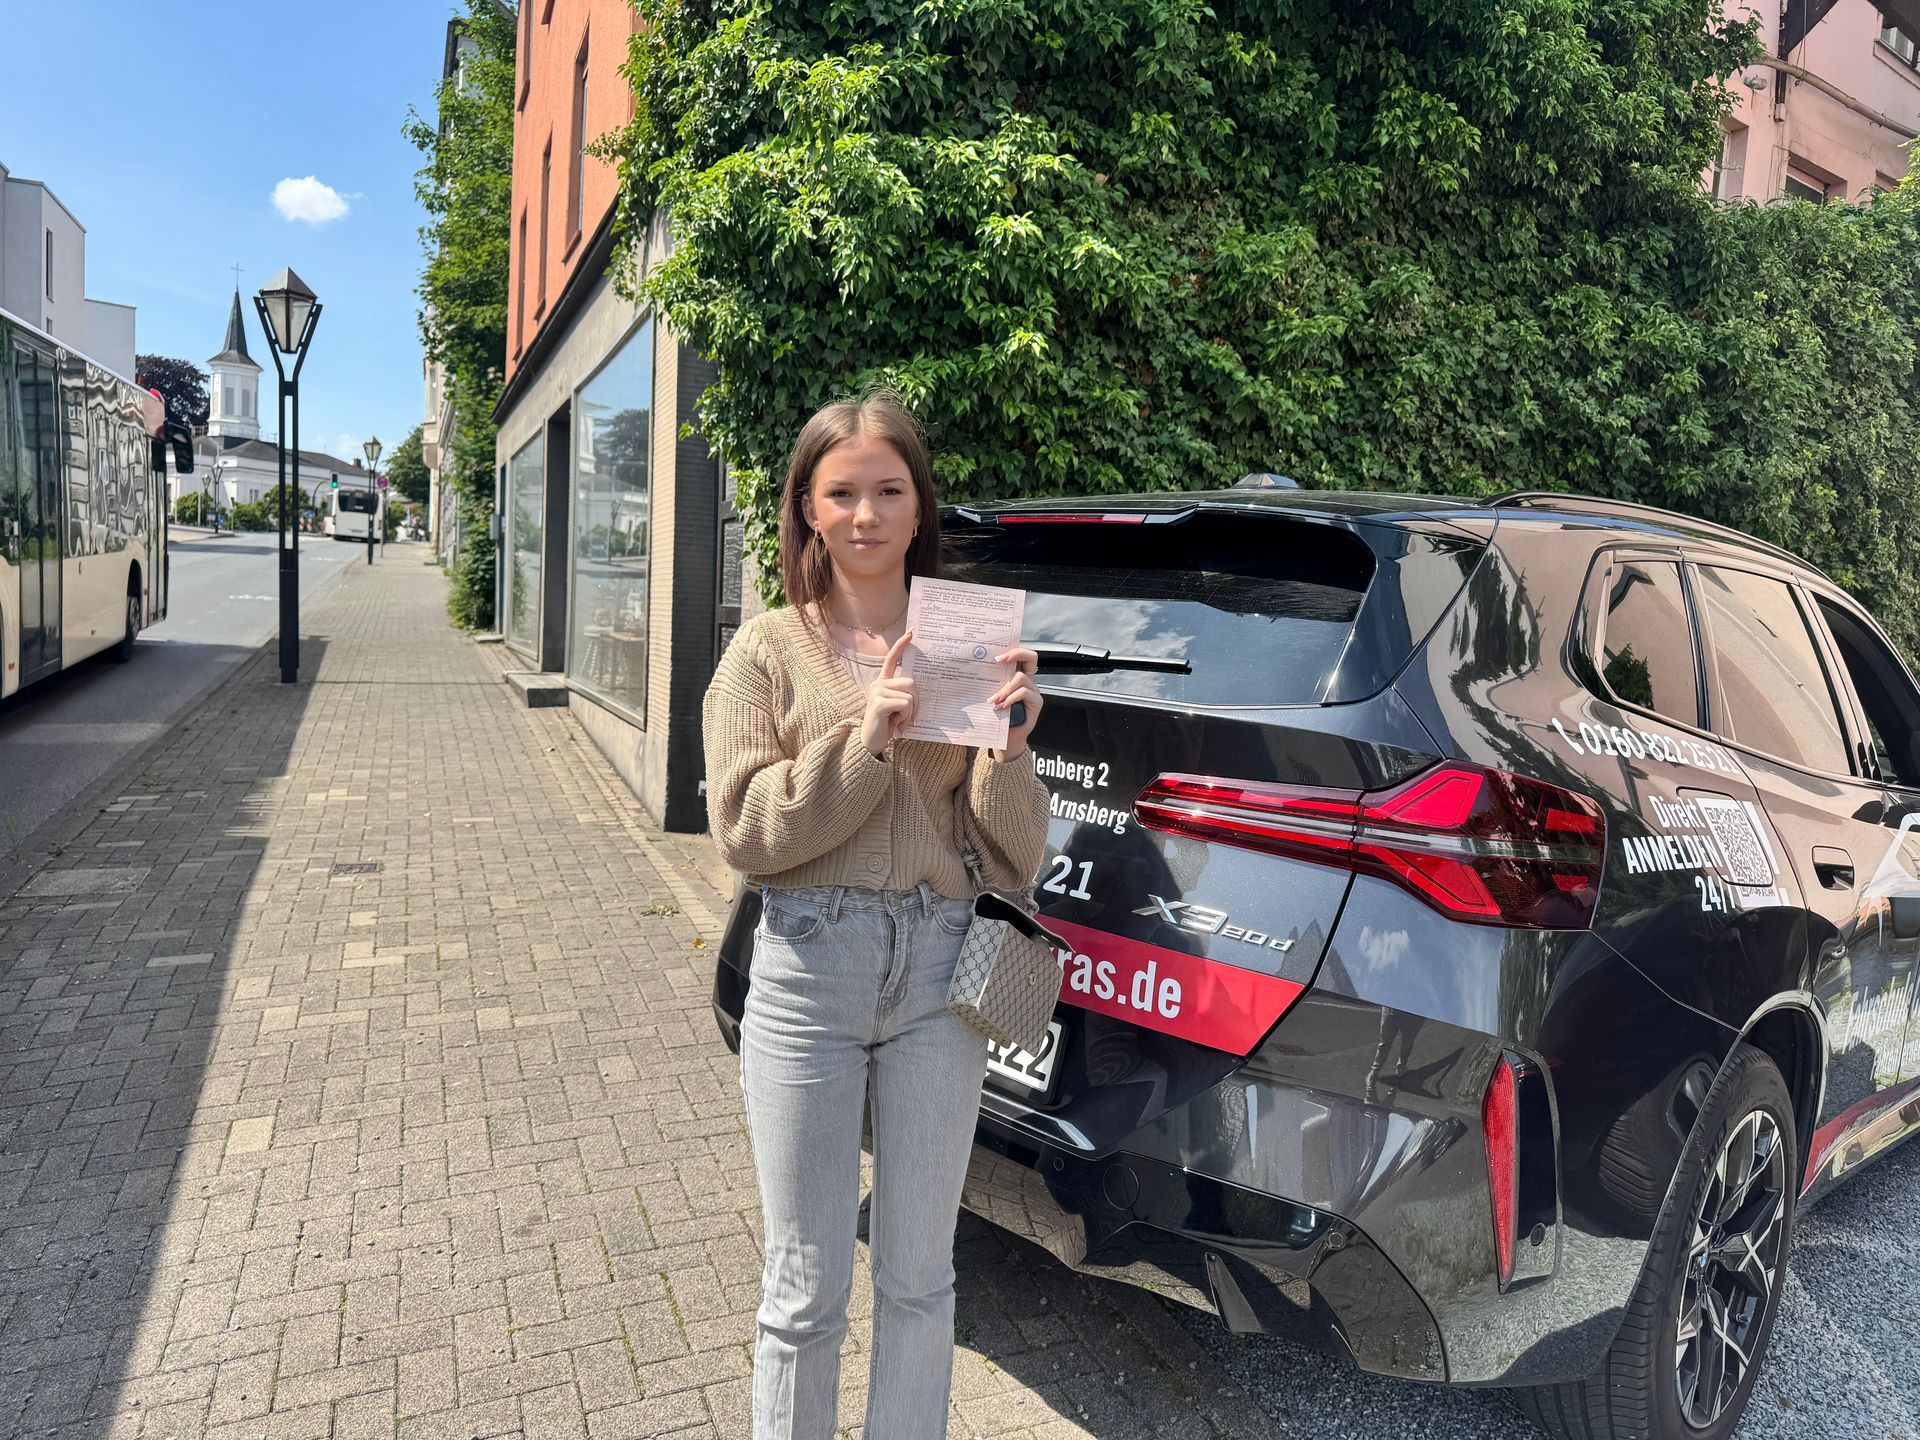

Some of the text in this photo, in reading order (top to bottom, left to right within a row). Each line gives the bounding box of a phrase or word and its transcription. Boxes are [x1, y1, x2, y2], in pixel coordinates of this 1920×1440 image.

[1579, 721, 1742, 775] 0160 822 25 21
[1097, 762, 1110, 787] 2
[1050, 792, 1130, 835] Arnsberg
[1648, 795, 1706, 828] Direkt
[1622, 835, 1723, 875] ANMELDEN
[1043, 855, 1093, 901] 21
[1695, 874, 1735, 913] 24/7
[1132, 894, 1296, 952] X3 20d
[1050, 946, 1182, 1019] ras.de
